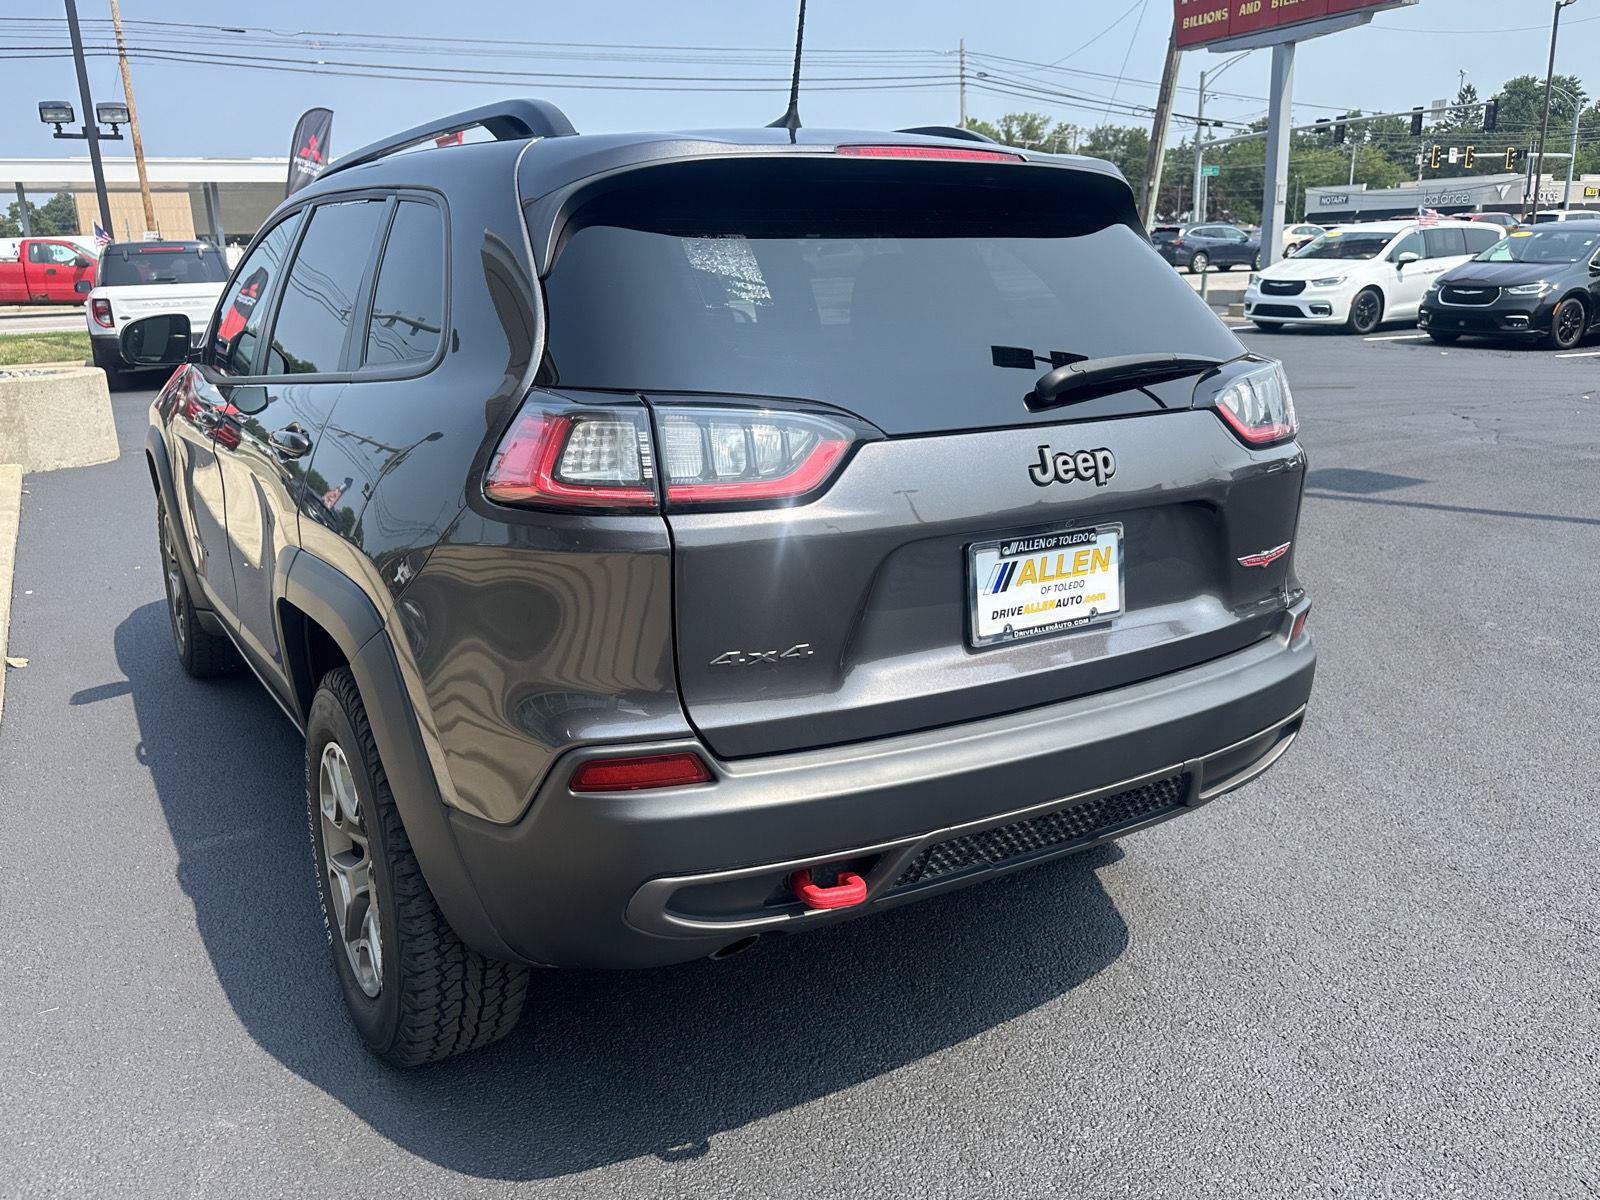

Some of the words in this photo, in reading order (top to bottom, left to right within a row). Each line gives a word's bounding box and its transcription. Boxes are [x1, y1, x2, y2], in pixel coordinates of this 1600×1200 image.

[1182, 8, 1229, 29] BILLIONS
[1238, 1, 1262, 16] AND
[1319, 195, 1348, 205] NOTARY
[1028, 445, 1117, 488] Jeep
[1017, 539, 1046, 552] ALLEN
[1046, 537, 1058, 548] OF
[1059, 533, 1089, 546] TOLEDO
[1016, 546, 1112, 587] ALLEN
[1040, 586, 1052, 595] OF
[1054, 579, 1085, 593] TOLEDO
